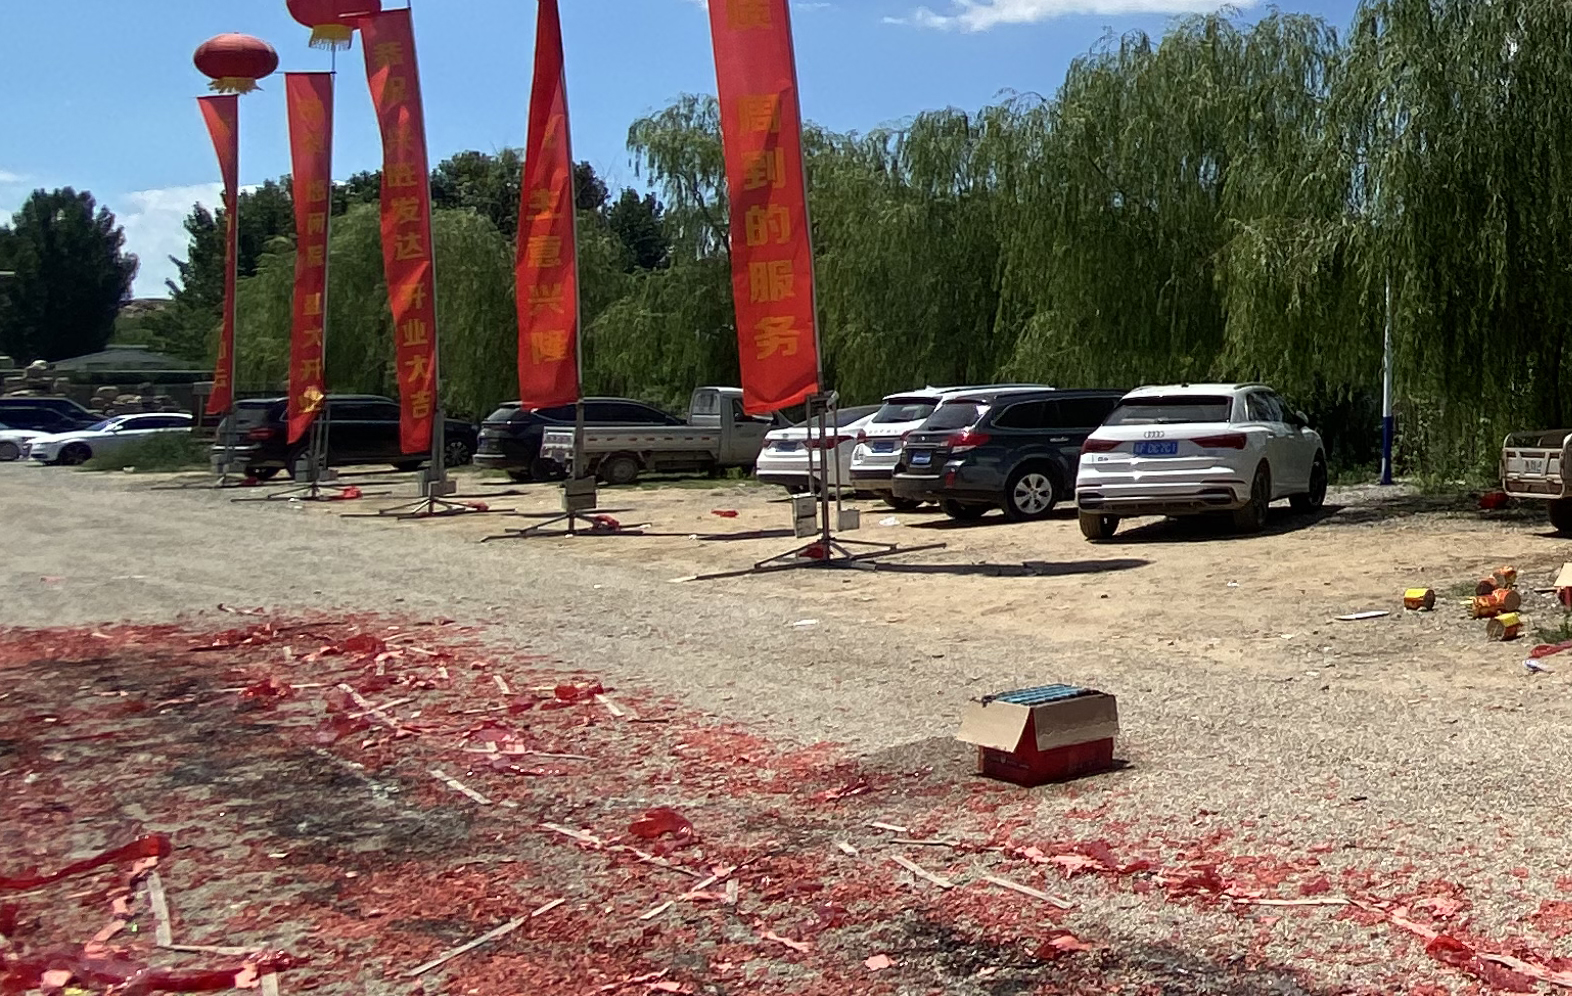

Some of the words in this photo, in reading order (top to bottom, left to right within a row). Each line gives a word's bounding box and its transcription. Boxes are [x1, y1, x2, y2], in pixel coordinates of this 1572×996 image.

[526, 188, 568, 365] 生意兴隆
[736, 93, 799, 359] 周到的服务
[400, 282, 432, 420] 开业大吉
